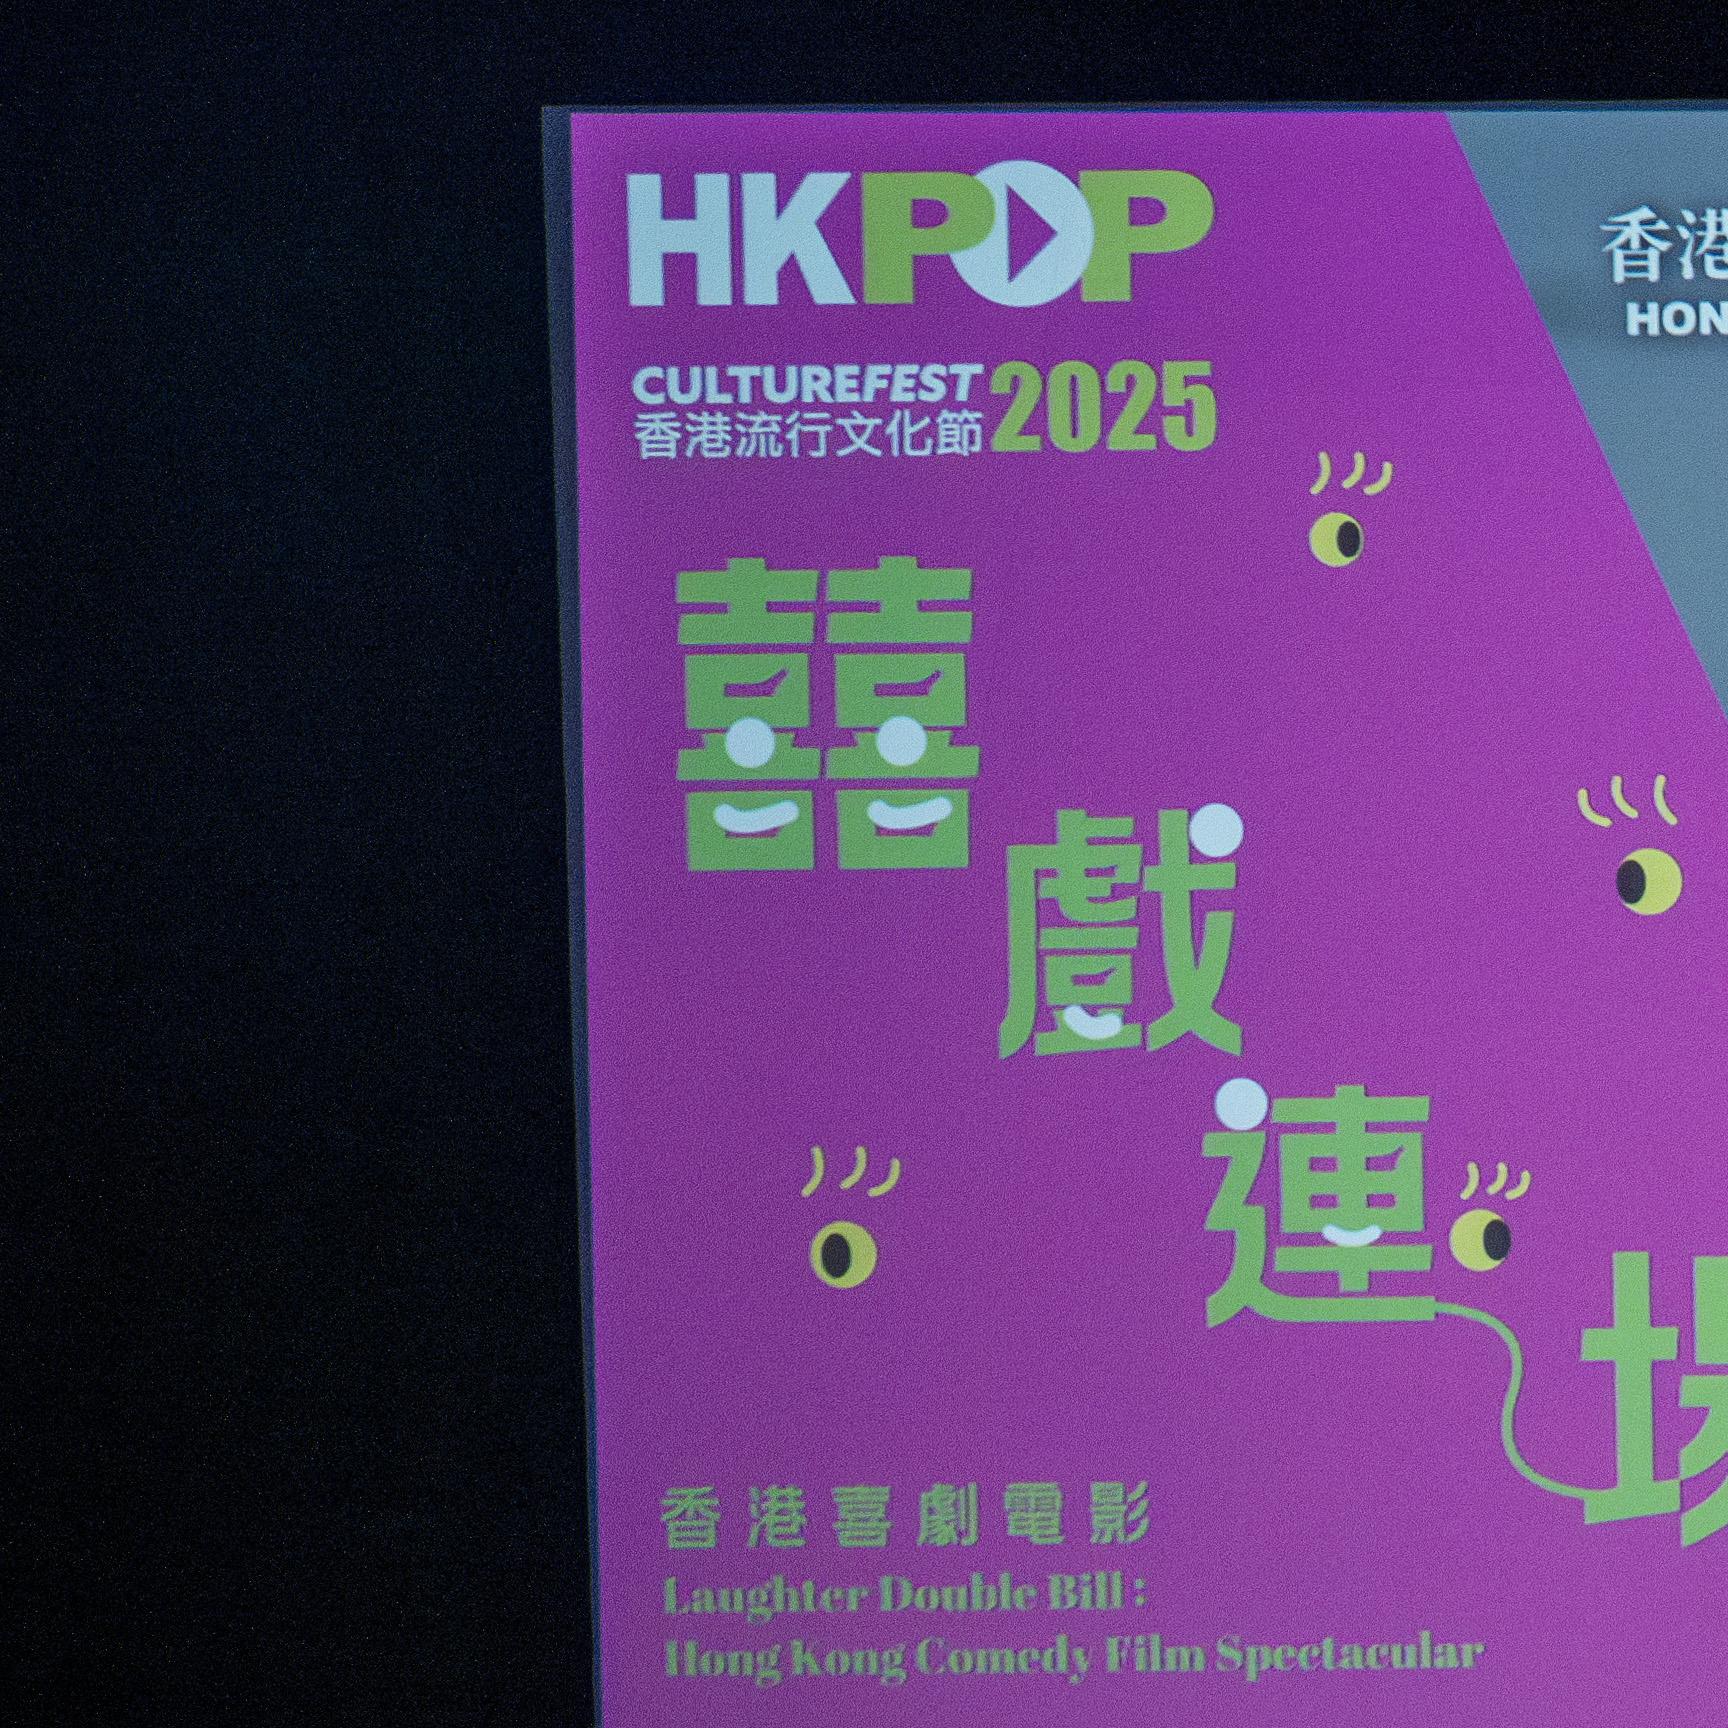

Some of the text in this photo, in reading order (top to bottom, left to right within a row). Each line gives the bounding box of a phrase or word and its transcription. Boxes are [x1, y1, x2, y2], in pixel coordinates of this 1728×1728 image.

[627, 160, 1214, 307] HKPOP
[632, 359, 1216, 452] CULTUREFEST 2025
[634, 411, 983, 460] 香港流行文化節
[661, 1481, 1150, 1549] 香港喜劇電影
[663, 1574, 868, 1625] Laughter
[880, 1571, 1037, 1613] Double
[664, 1630, 1485, 1688] Hong Kong Comedy Film Spectacular
